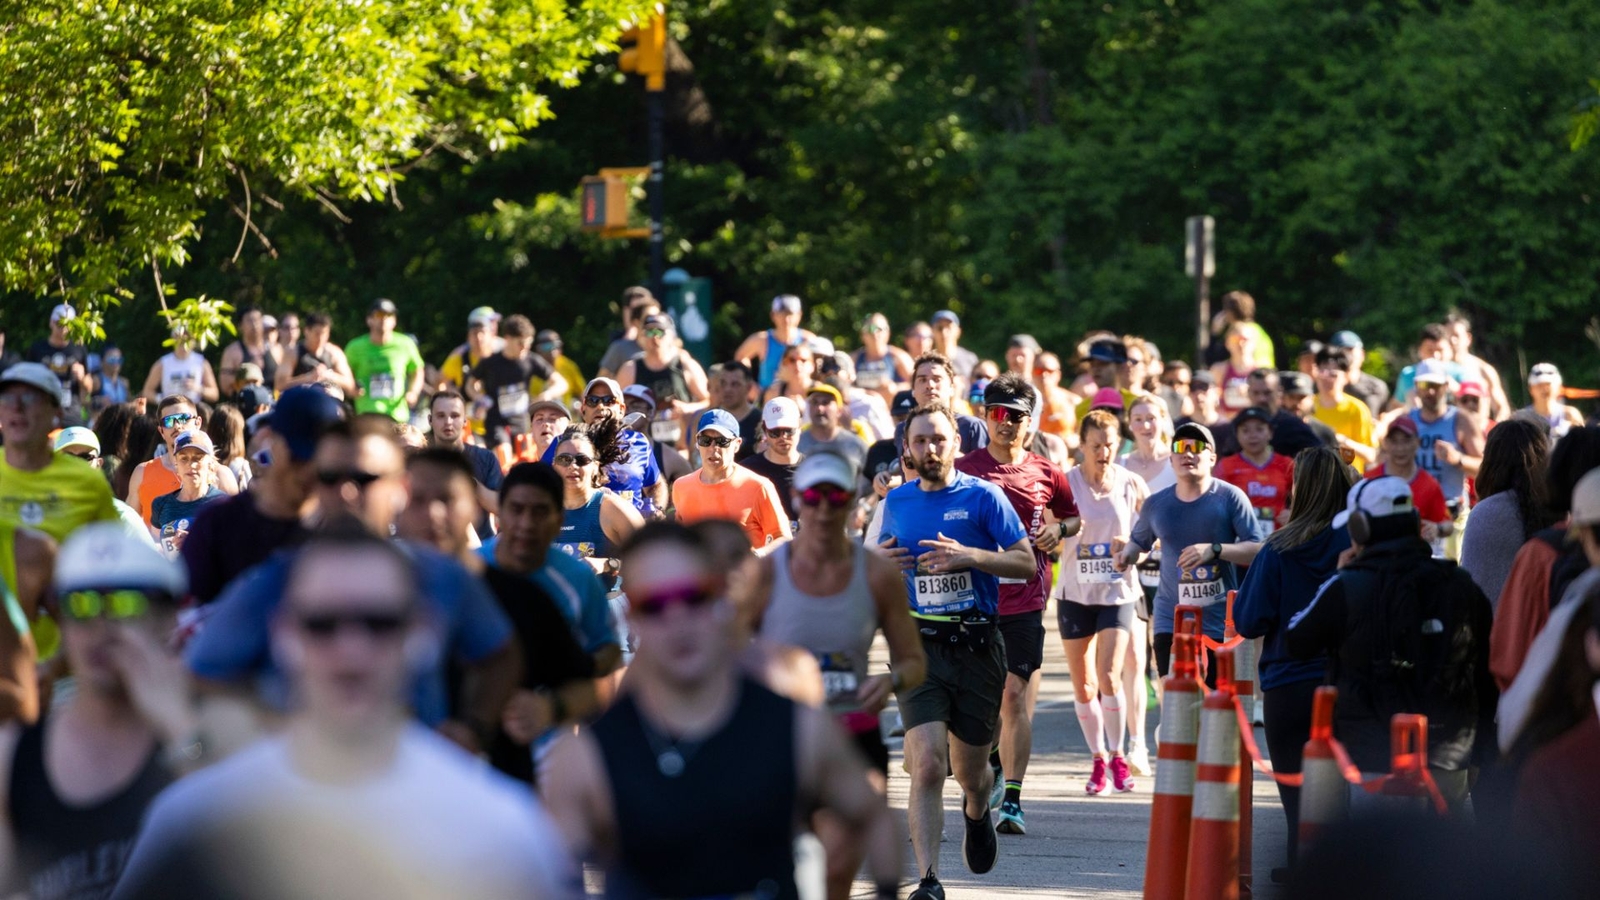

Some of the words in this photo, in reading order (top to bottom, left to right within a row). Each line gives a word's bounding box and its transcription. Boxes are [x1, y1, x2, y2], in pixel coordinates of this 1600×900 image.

[1080, 561, 1118, 574] B1495
[918, 575, 967, 594] B13860
[1182, 582, 1222, 599] A11480
